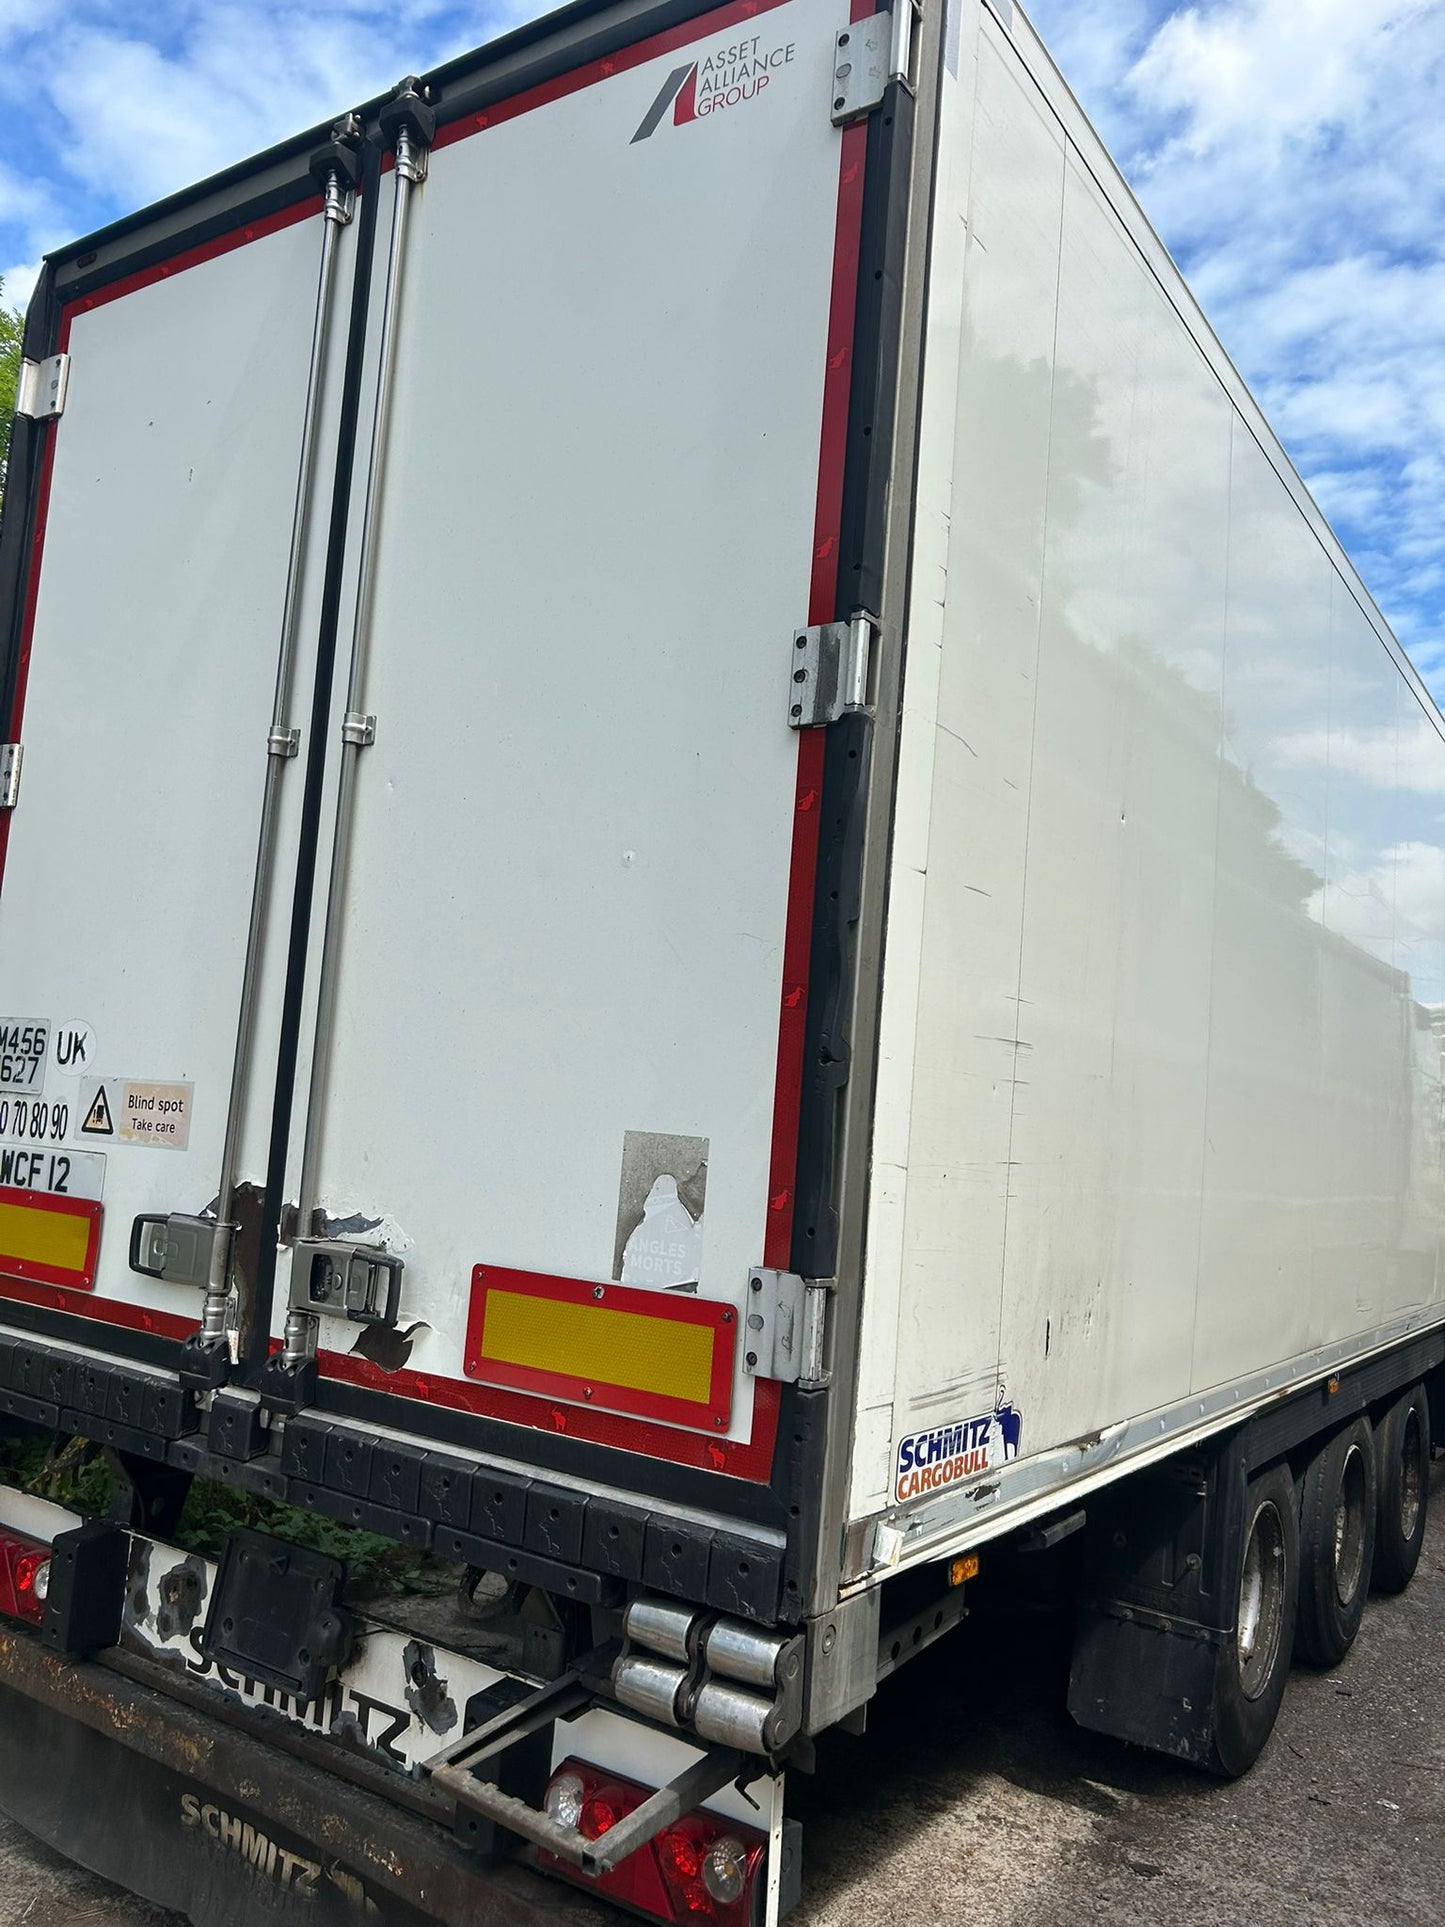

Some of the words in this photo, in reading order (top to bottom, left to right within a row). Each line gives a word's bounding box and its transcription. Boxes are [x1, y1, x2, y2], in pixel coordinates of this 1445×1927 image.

[699, 43, 796, 97] ALLIANCE
[701, 36, 761, 76] ASSET
[697, 75, 770, 117] GROUP
[57, 1030, 88, 1065] UK
[0, 1055, 39, 1084] 627
[12, 1100, 28, 1137] 70
[30, 1102, 48, 1139] 80
[50, 1103, 68, 1141] 90
[128, 1094, 154, 1111] Blind
[158, 1098, 184, 1115] spot
[132, 1117, 153, 1132] Take
[155, 1121, 176, 1134] care
[629, 1238, 687, 1259] ANGLES
[629, 1254, 682, 1275] MORTS
[899, 1415, 993, 1473] SCHMITZ
[898, 1447, 989, 1500] CARGOBULL
[180, 1793, 322, 1898] SCHMITZ
